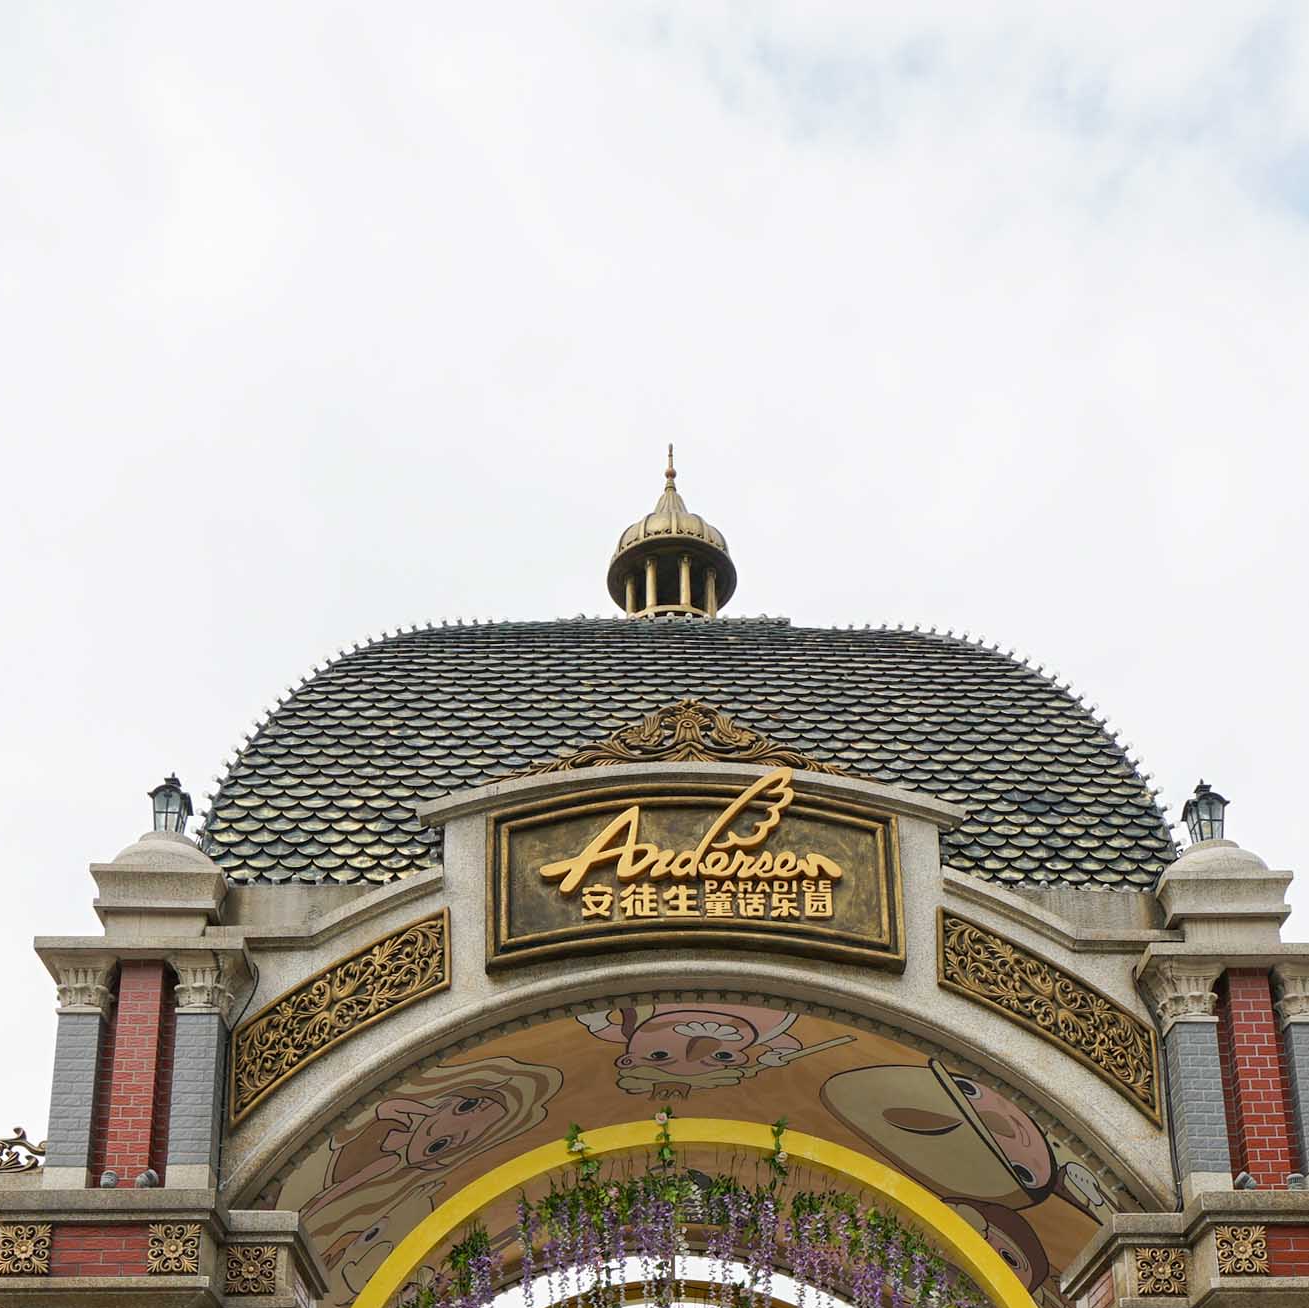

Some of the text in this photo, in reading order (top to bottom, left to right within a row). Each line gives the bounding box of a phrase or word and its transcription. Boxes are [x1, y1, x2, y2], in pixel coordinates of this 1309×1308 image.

[539, 767, 843, 894] Andersen
[581, 883, 834, 919] 安徒生童话乐园
[704, 879, 832, 893] PARADISE
